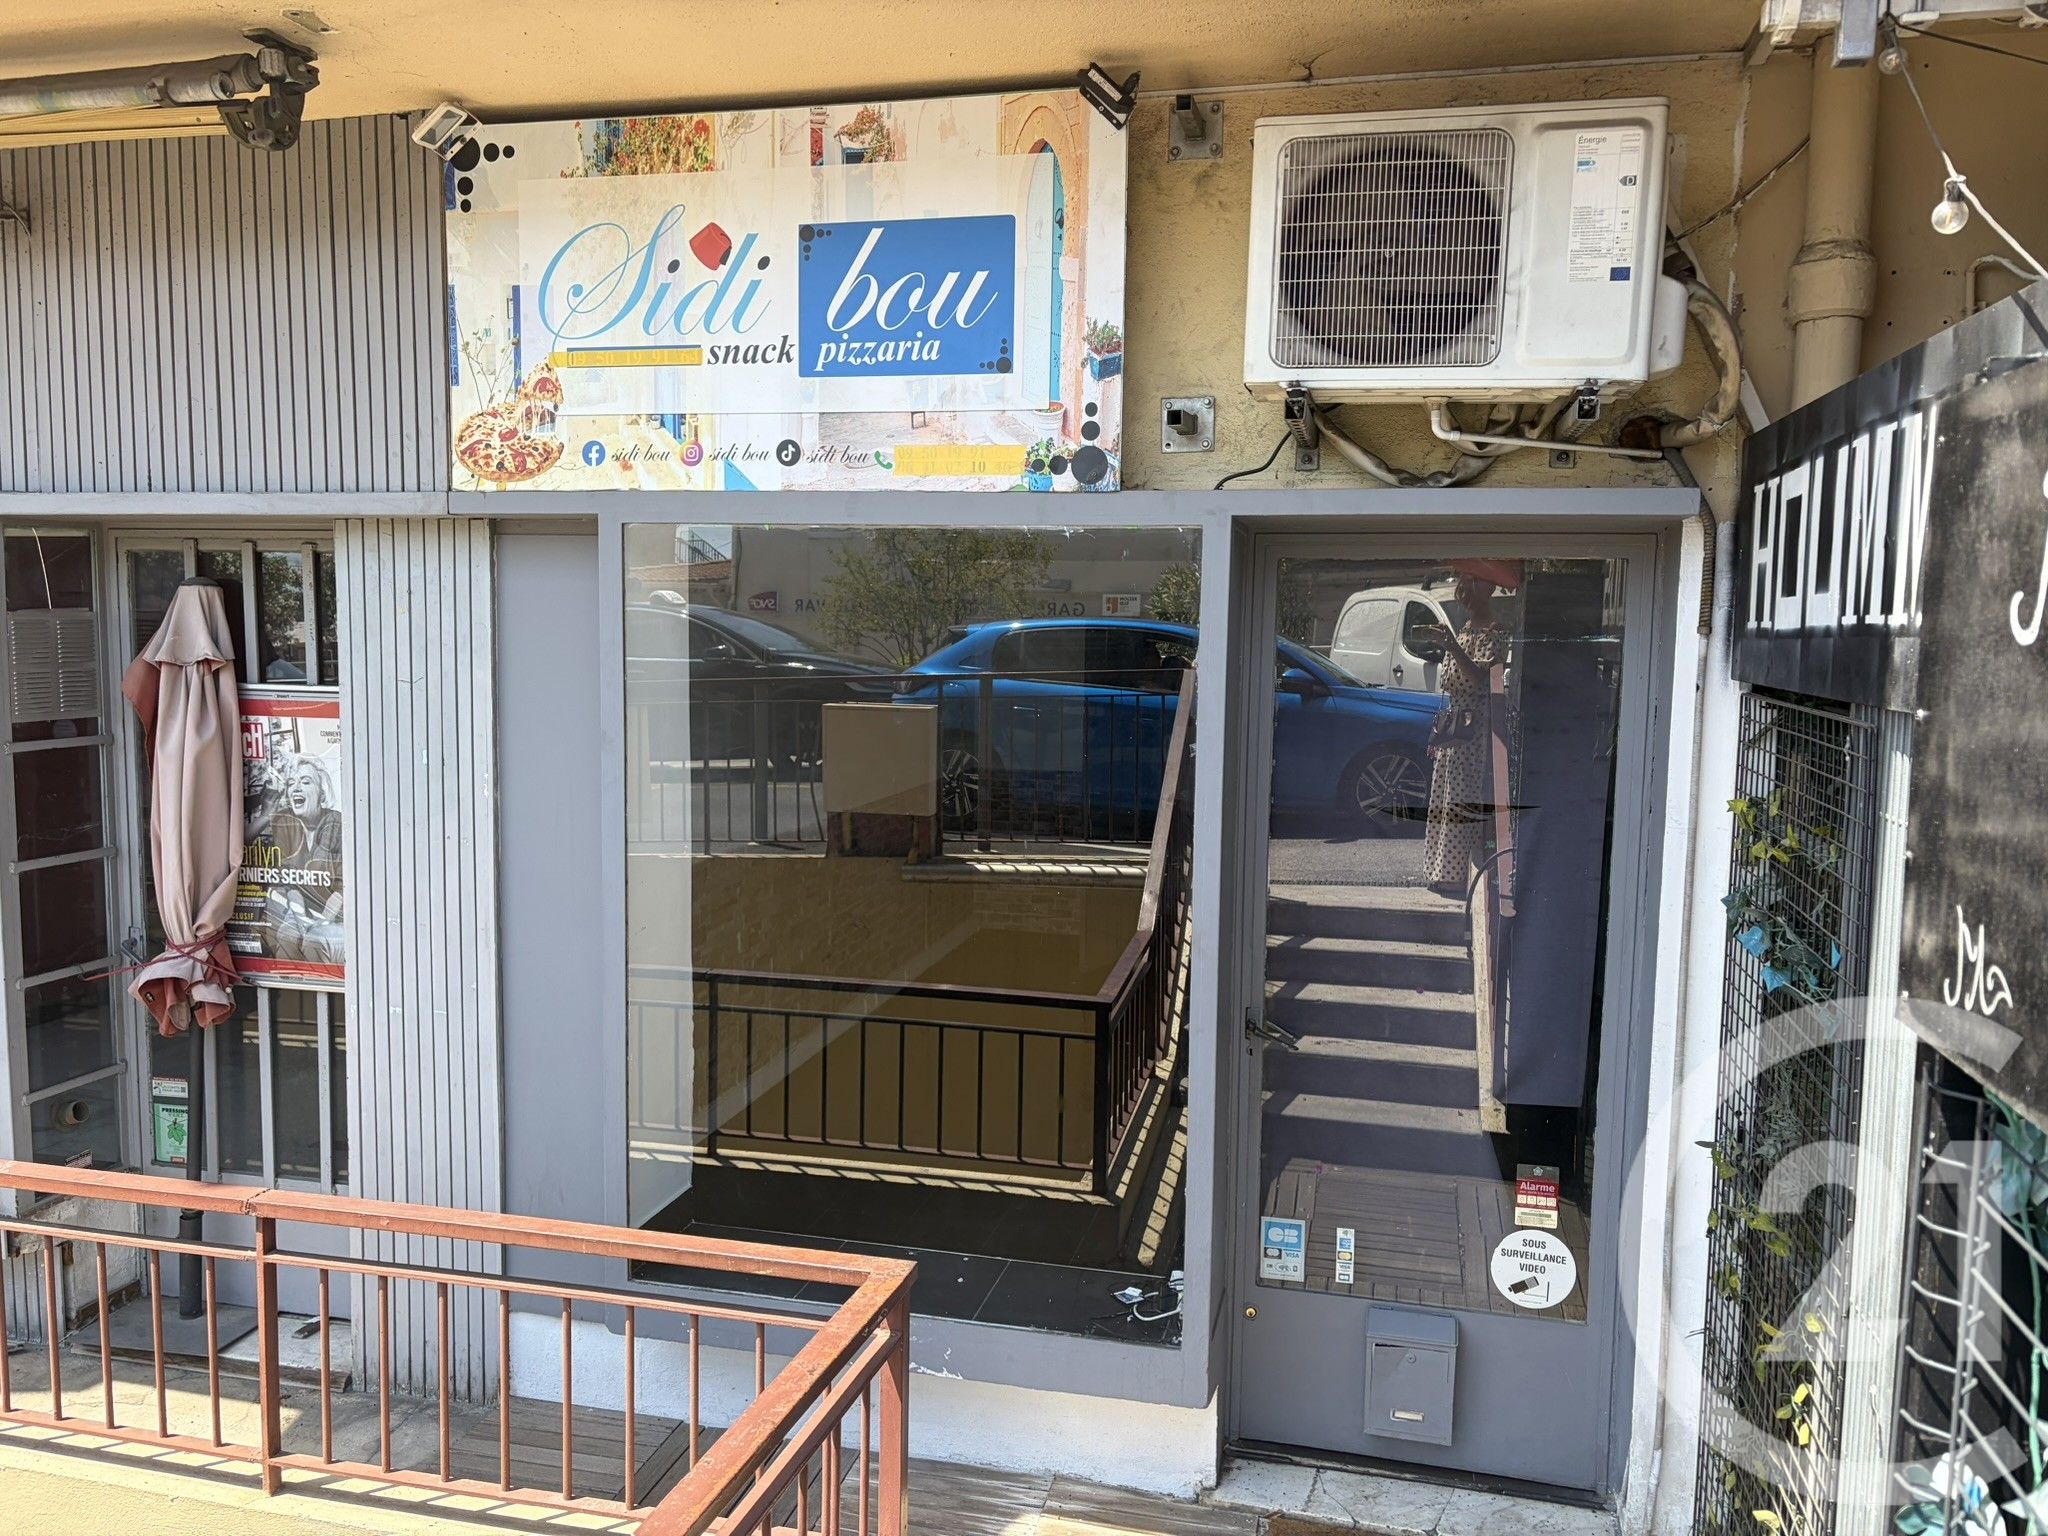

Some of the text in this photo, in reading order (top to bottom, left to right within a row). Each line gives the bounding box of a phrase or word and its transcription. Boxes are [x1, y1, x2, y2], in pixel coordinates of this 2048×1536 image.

[1578, 135, 1607, 145] Énergie
[538, 204, 998, 353] Sidi bou
[708, 335, 796, 366] snack
[814, 331, 941, 371] pizzaria
[611, 444, 642, 462] sidi
[643, 443, 672, 462] bou
[708, 443, 739, 462] sidi
[741, 443, 771, 461] bou
[840, 445, 870, 463] bou
[281, 869, 331, 886] SECRETS
[1520, 1182, 1555, 1192] Alarme
[1522, 1239, 1546, 1249] SOUS
[1501, 1249, 1567, 1265] SURVEILLANCE
[1519, 1263, 1546, 1274] VIDEO
